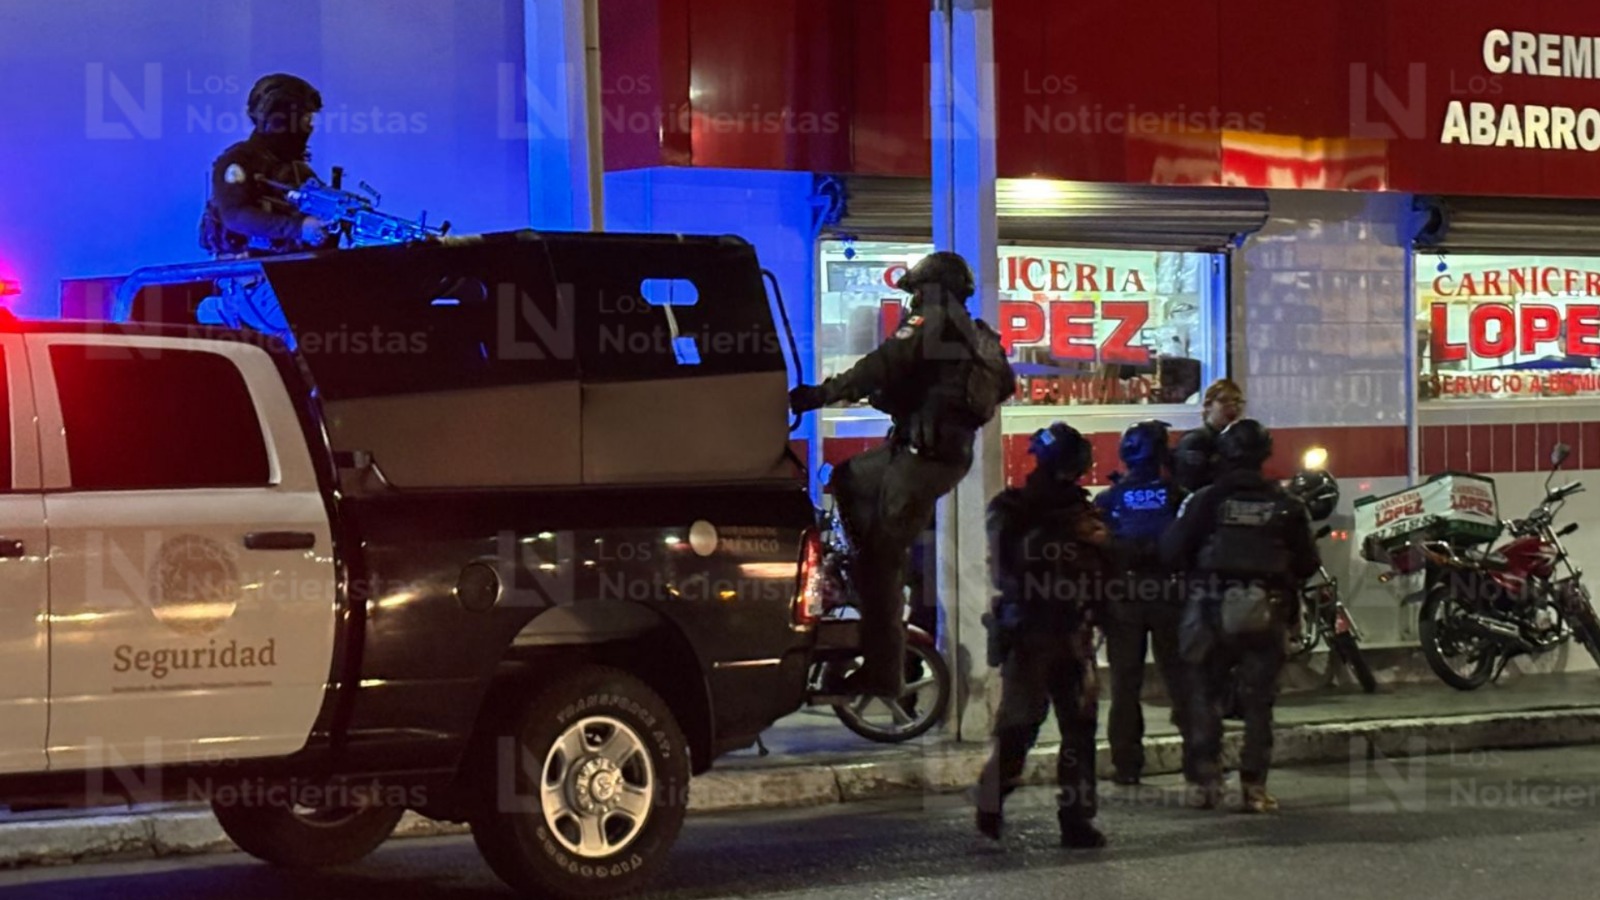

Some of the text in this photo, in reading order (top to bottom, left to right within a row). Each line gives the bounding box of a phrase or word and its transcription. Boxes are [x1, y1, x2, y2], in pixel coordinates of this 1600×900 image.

[1441, 100, 1600, 151] ABARRO
[884, 256, 1146, 292] CICERIA
[880, 299, 1151, 365] LPEZ
[1431, 302, 1600, 363] LOPE
[1375, 499, 1425, 527] LOPEZ
[113, 637, 277, 679] Seguridad
